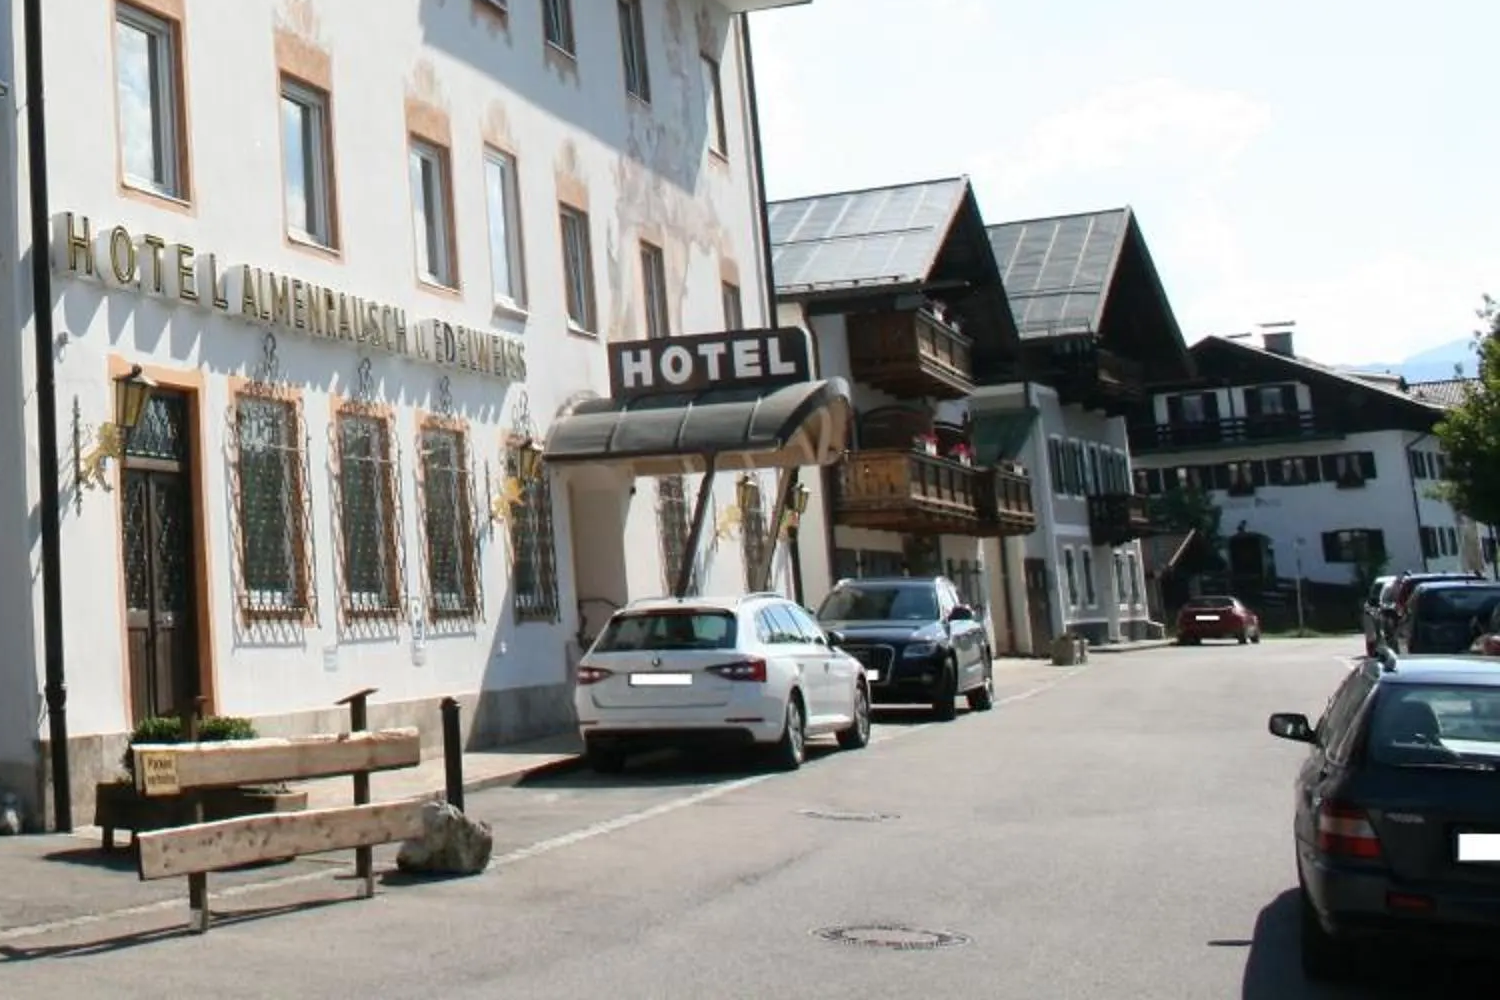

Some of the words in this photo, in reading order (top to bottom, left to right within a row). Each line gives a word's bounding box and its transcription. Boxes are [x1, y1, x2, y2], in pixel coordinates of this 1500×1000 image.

[57, 211, 229, 309] HOTEL
[241, 263, 409, 355] ALMENRAUSCH
[432, 317, 527, 382] EDELWEISS
[621, 337, 797, 389] HOTEL
